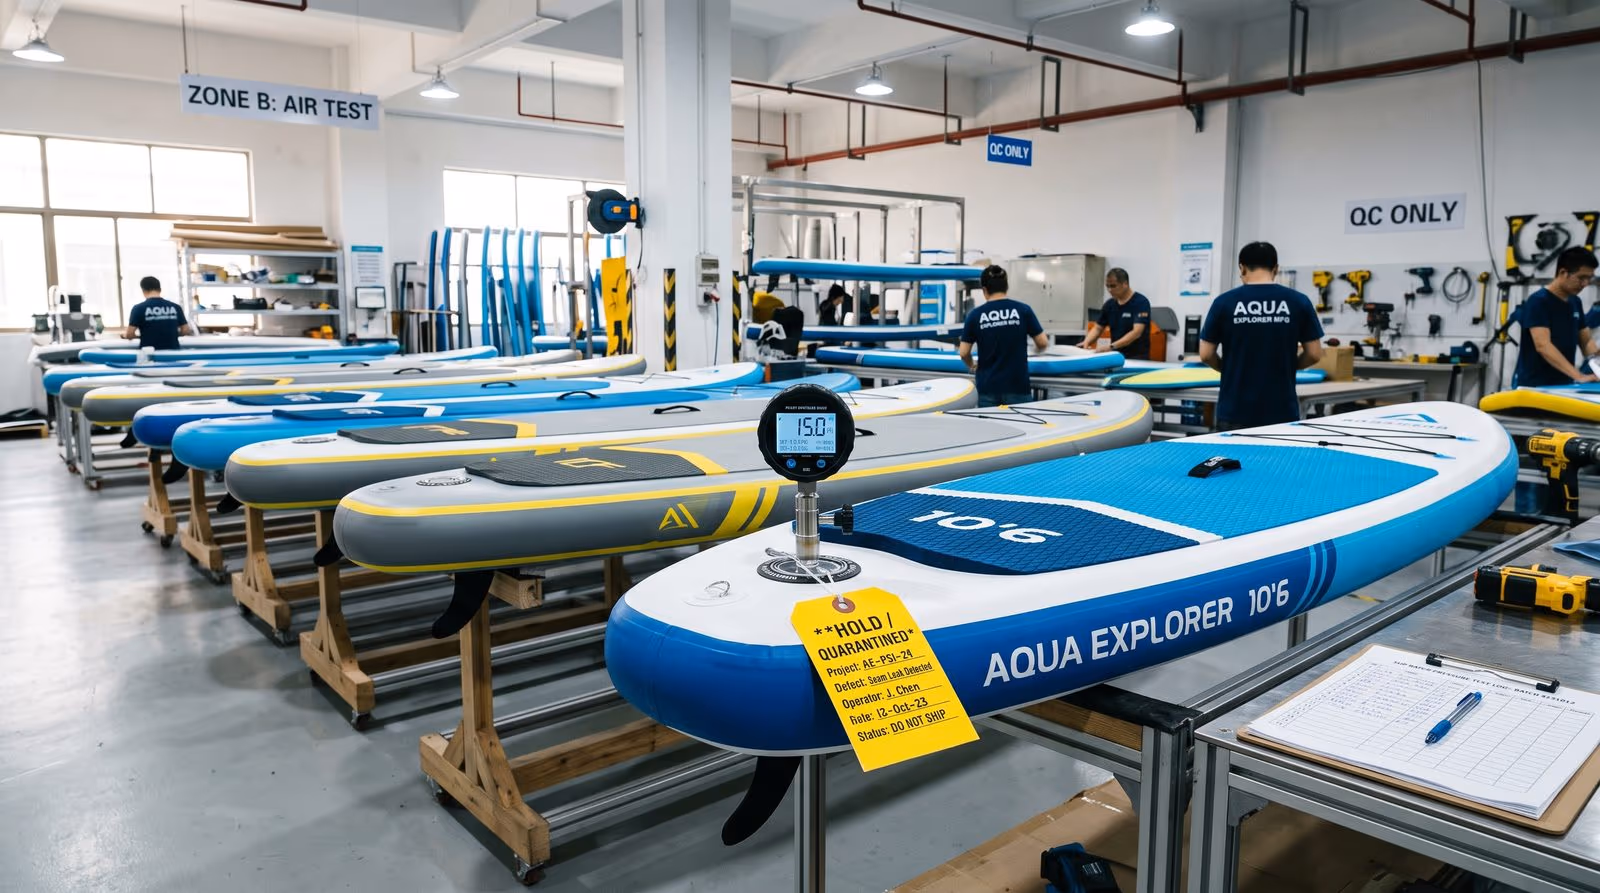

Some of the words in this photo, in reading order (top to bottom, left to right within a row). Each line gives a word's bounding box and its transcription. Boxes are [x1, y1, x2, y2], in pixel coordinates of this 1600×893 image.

[188, 84, 250, 109] ZONE
[257, 92, 277, 111] B:
[283, 95, 318, 116] AIR
[323, 99, 372, 121] TEST
[990, 142, 1003, 156] QC
[1004, 144, 1029, 159] ONLY
[1350, 206, 1383, 226] QC
[1390, 200, 1458, 225] ONLY
[145, 306, 178, 316] AQUA
[979, 308, 1020, 324] AQUA
[1233, 300, 1291, 316] AQUA
[1233, 316, 1272, 325] EXPLORER
[797, 417, 826, 437] 15.0
[909, 509, 1064, 544] 10'6
[983, 635, 1084, 687] AQUA
[1090, 596, 1234, 661] EXPLORER
[1248, 578, 1290, 617] 10'6
[826, 662, 861, 678] Project:
[862, 649, 914, 670] AE-PSI-24
[834, 677, 868, 693] Defect:
[867, 674, 888, 686] Seam
[889, 669, 905, 681] Leak
[905, 661, 933, 677] Detected
[842, 692, 885, 710] Operator:
[886, 688, 895, 699] J.
[896, 683, 921, 696] Chen
[877, 697, 929, 719] 12-Oct-23
[857, 727, 890, 742] Status:
[890, 721, 905, 733] DO
[905, 716, 924, 730] NOT
[926, 708, 946, 723] SHIP
